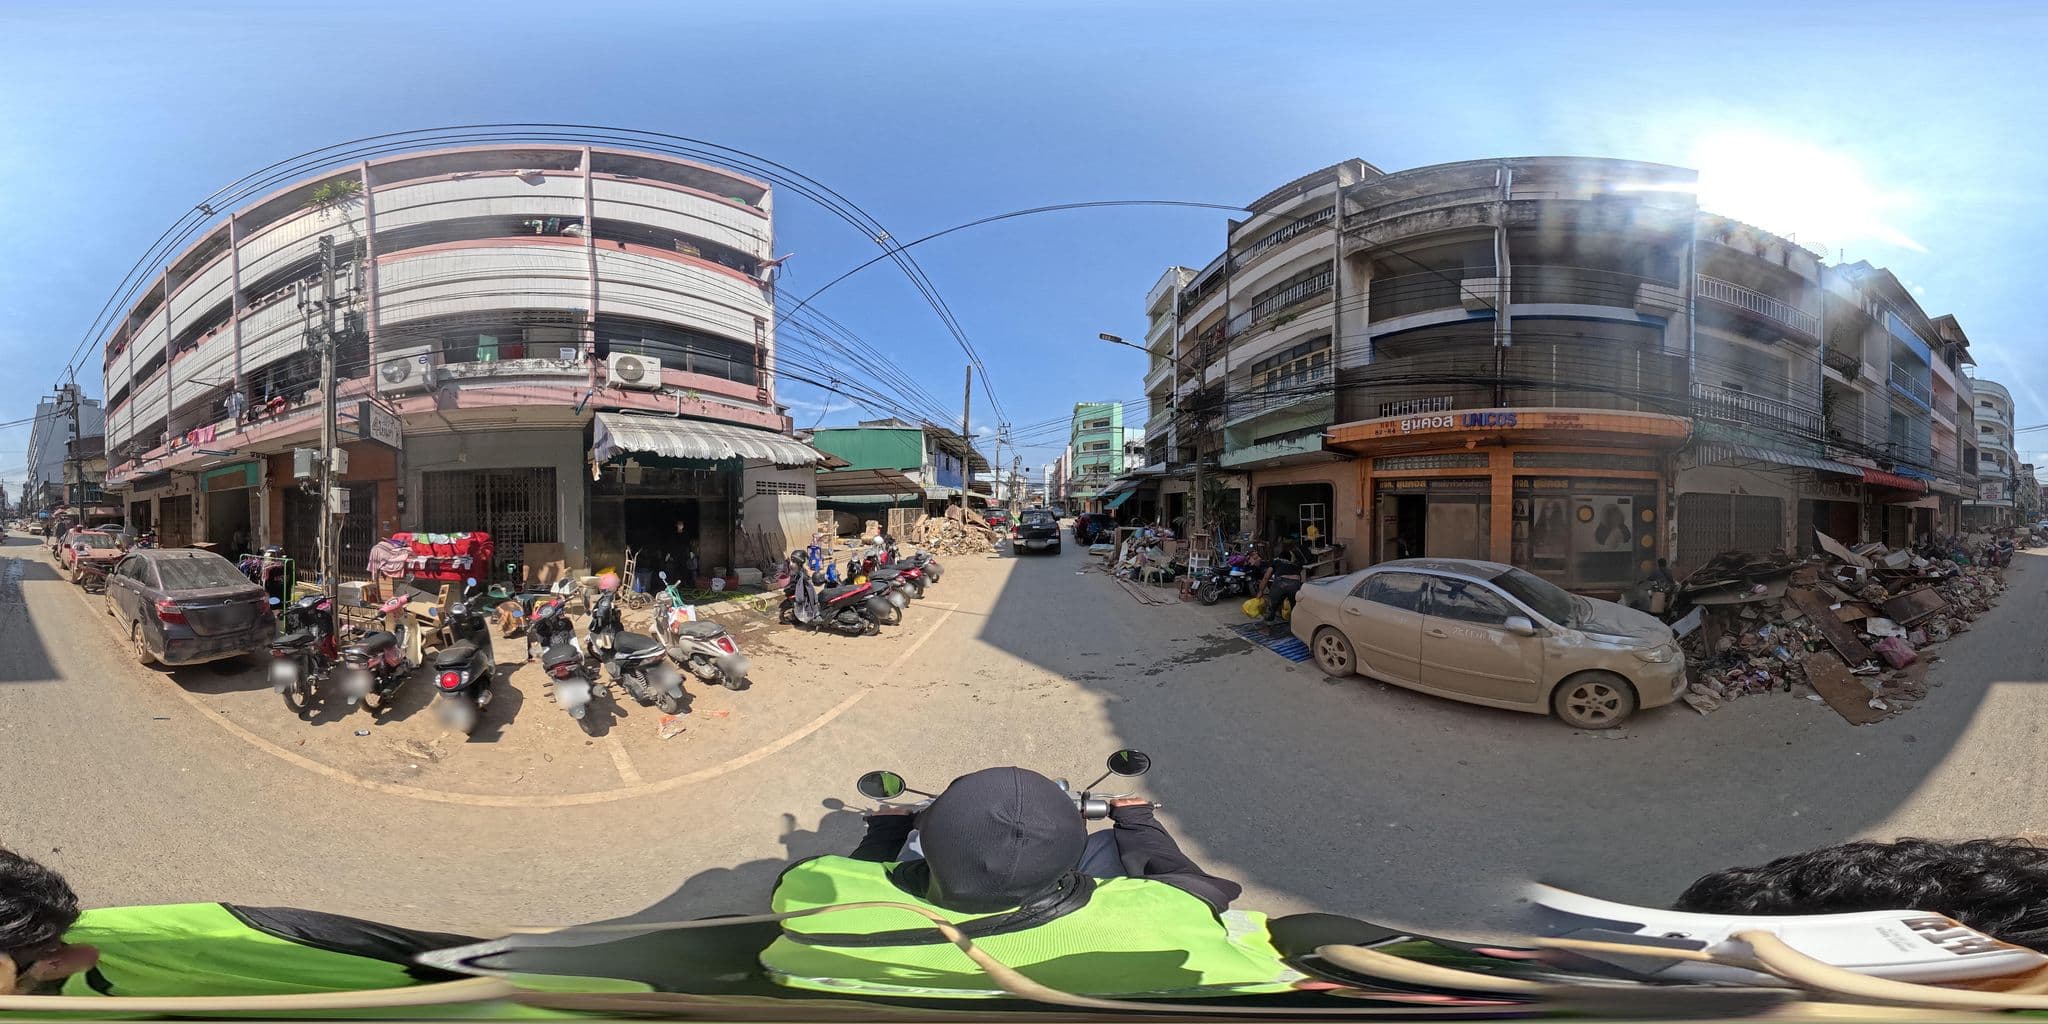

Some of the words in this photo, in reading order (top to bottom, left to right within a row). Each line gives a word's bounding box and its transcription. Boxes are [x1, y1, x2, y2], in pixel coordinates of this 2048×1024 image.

[1401, 414, 1454, 434] ยูนิคอส
[1462, 413, 1517, 427] UNICOS
